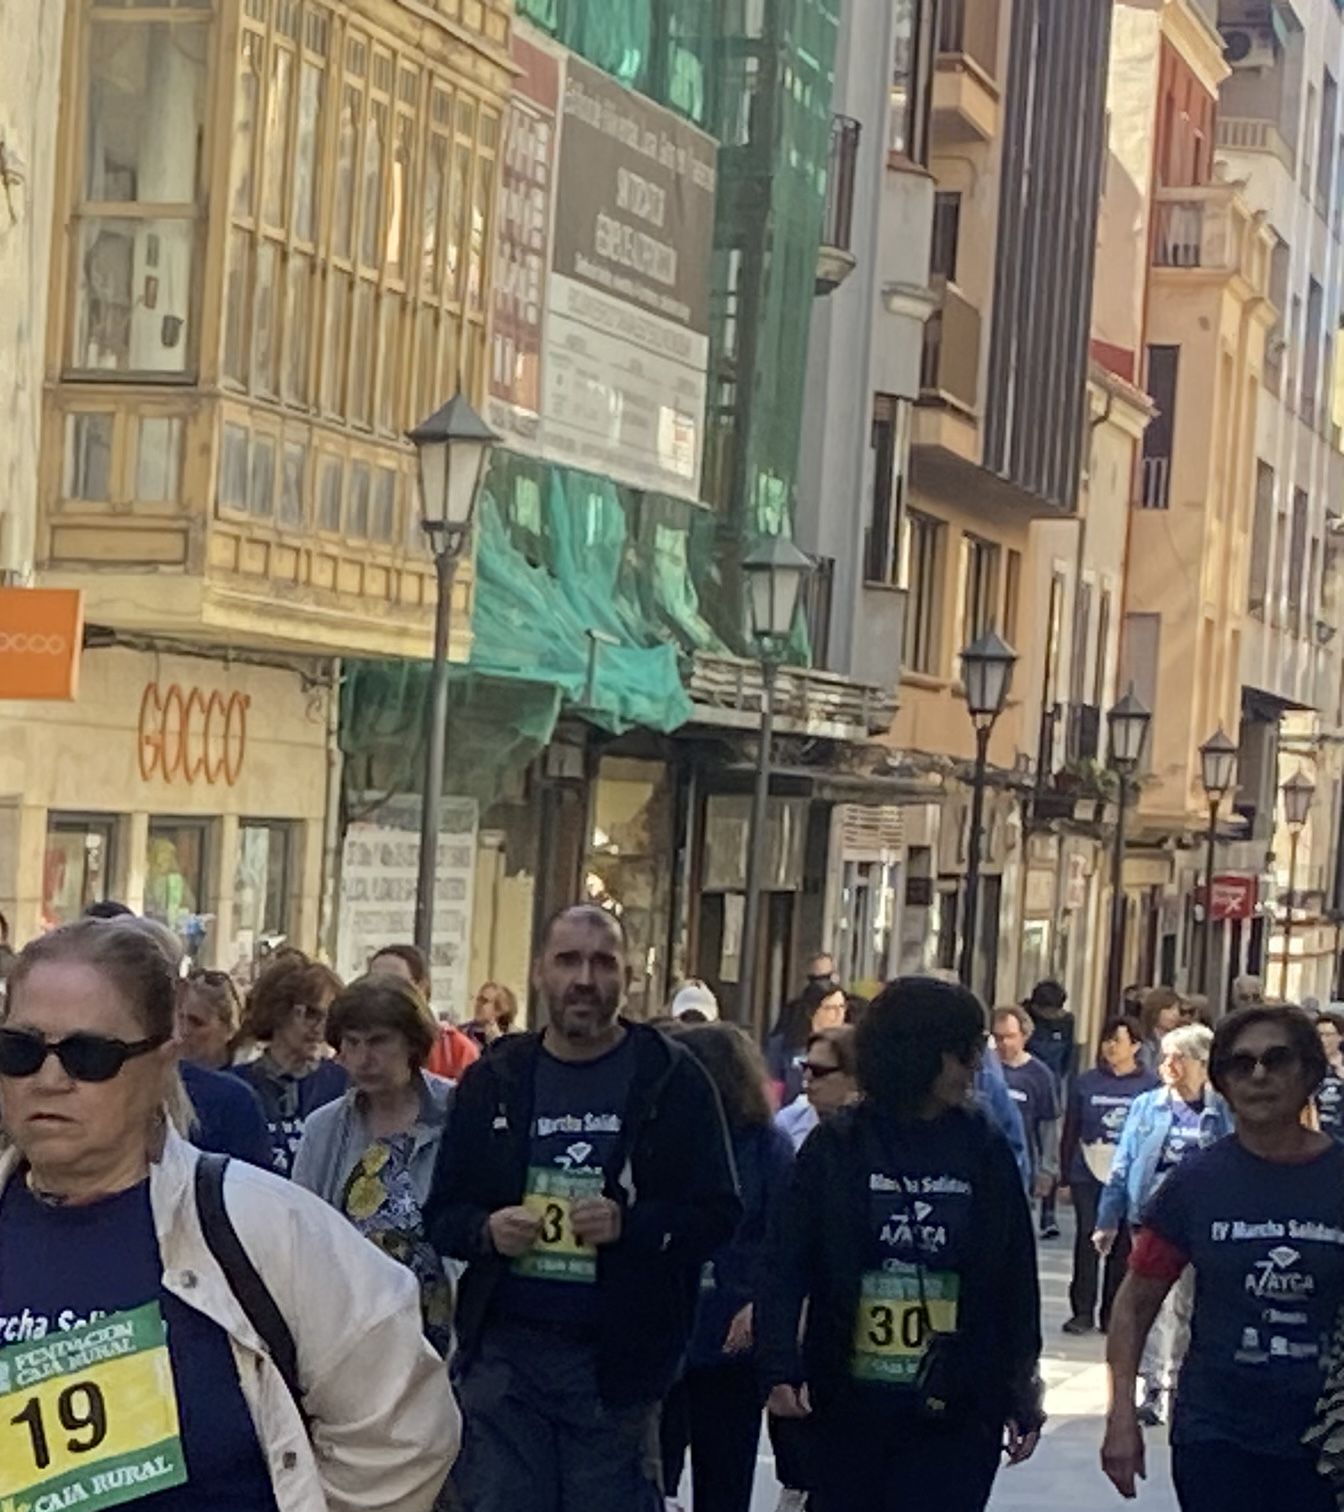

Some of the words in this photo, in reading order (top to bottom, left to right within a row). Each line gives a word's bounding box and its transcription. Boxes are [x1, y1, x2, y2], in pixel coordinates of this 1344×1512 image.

[138, 681, 246, 787] GOCCO
[14, 1320, 135, 1373] FUNDACION
[867, 1305, 923, 1349] 30
[16, 1362, 65, 1387] CAJA
[66, 1337, 137, 1373] RURAL
[10, 1380, 108, 1470] 19
[92, 1454, 175, 1496] RURAL
